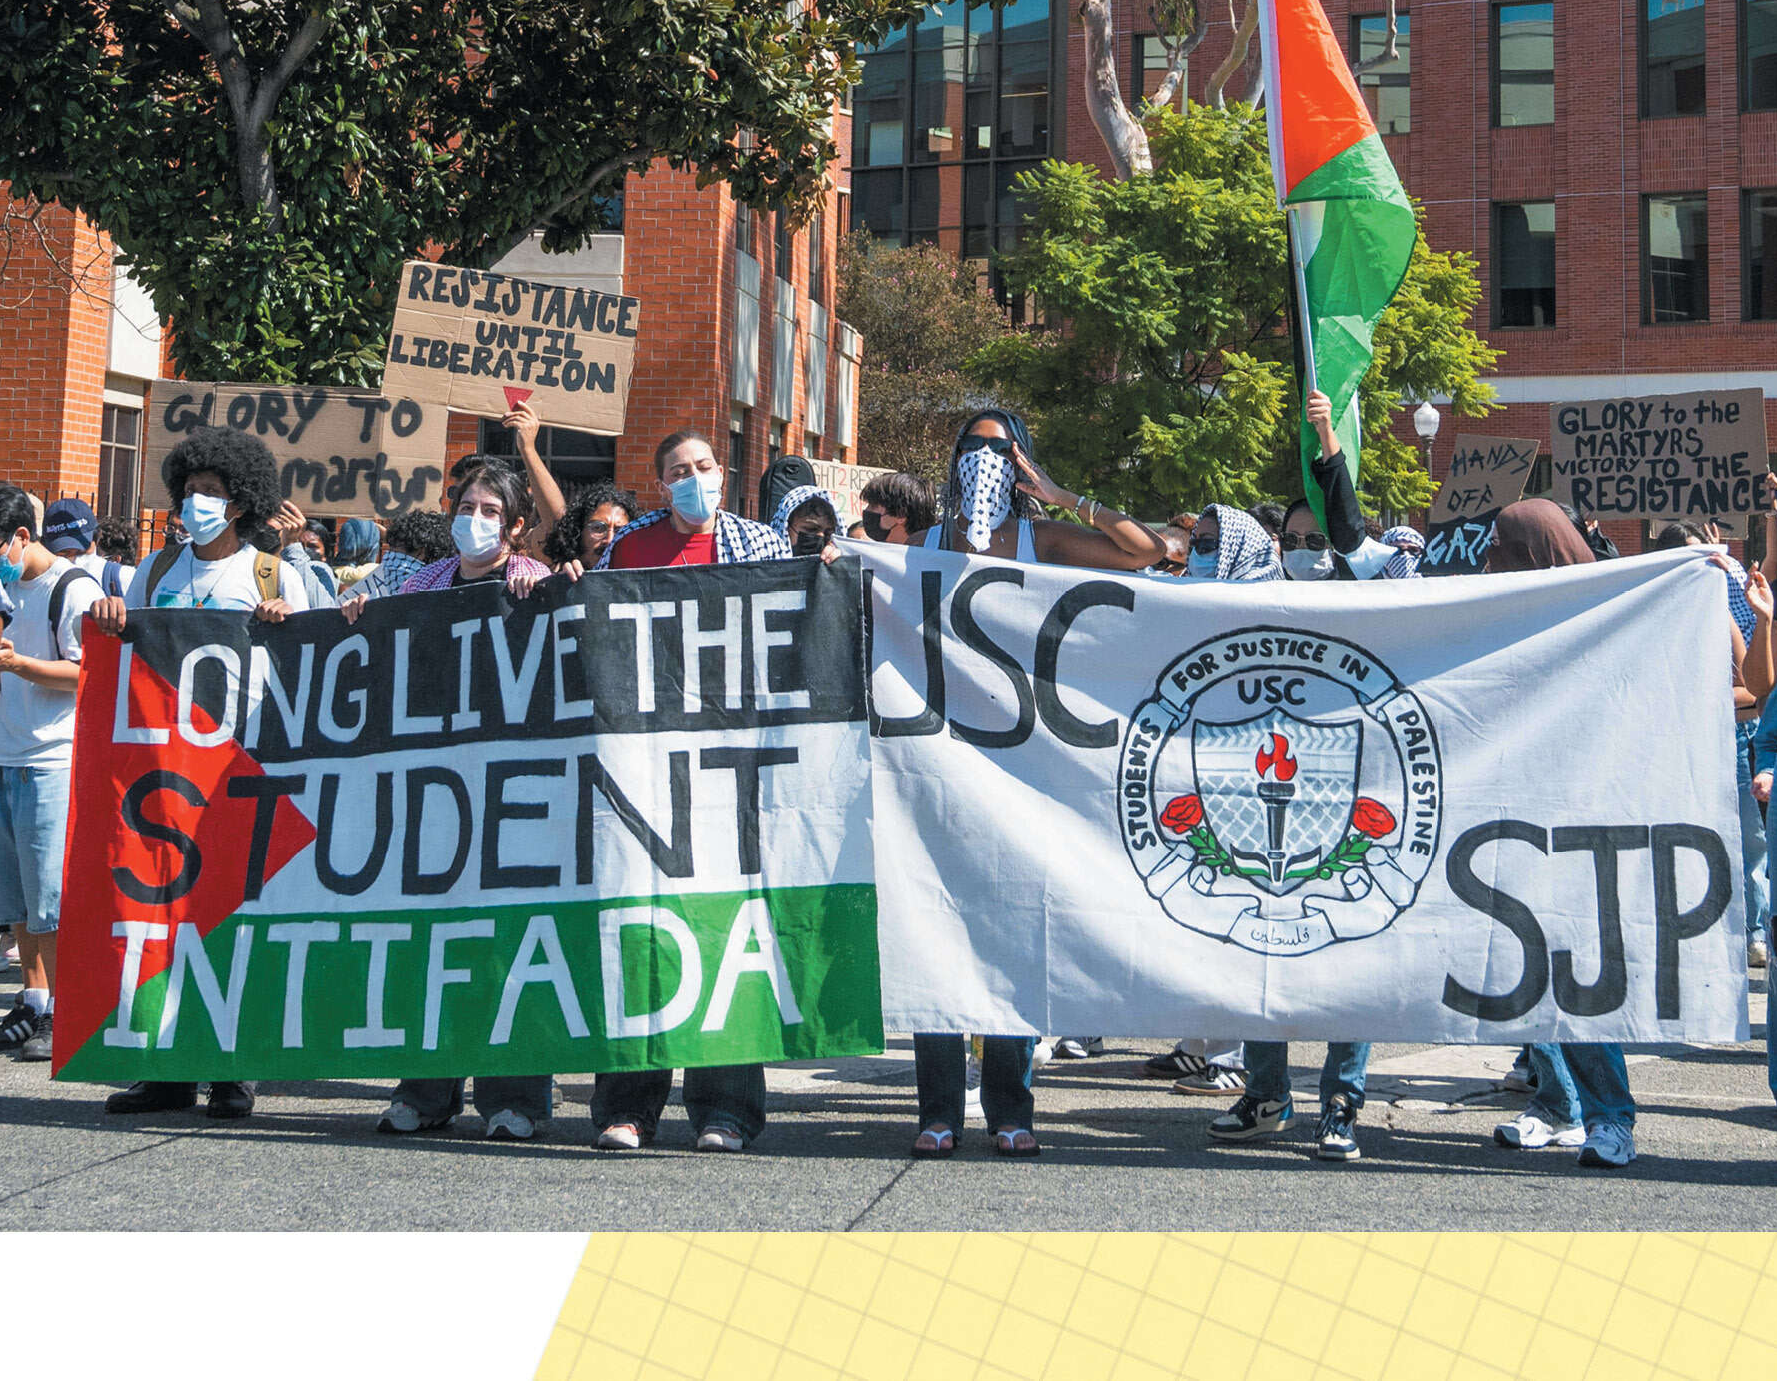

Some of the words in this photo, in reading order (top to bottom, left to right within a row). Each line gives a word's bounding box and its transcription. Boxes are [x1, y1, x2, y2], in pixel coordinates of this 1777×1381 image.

[408, 264, 639, 337] RESISTANCE
[475, 320, 583, 358] UNTIL
[390, 334, 616, 394] LIBERATION
[163, 390, 322, 444] GLORY
[348, 395, 423, 443] TO
[1558, 400, 1654, 435] GLORY
[1659, 401, 1687, 425] to
[1693, 399, 1740, 425] the
[1450, 442, 1534, 477] HANDS
[1554, 457, 1640, 476] VICTORY
[1645, 457, 1681, 479] TO
[1692, 451, 1751, 479] THE
[1575, 427, 1704, 458] MARTYRS
[1446, 483, 1494, 514] OFF
[1572, 473, 1772, 515] RESISTANCE
[110, 633, 369, 749] LONG
[390, 607, 595, 738] LIVE
[609, 589, 811, 712] THE
[863, 567, 1136, 749] USC
[1237, 675, 1307, 706] USC
[1127, 717, 1162, 852] STUDENTS
[1171, 652, 1220, 692] FOR
[1223, 637, 1328, 664] JUSTICE
[1338, 653, 1370, 682] IN
[1395, 707, 1437, 858] PALESTINE
[111, 745, 799, 906] STUDENT
[1250, 924, 1310, 946] فلسطين
[1444, 819, 1734, 1020] SJP
[102, 897, 802, 1051] INTIFADA
